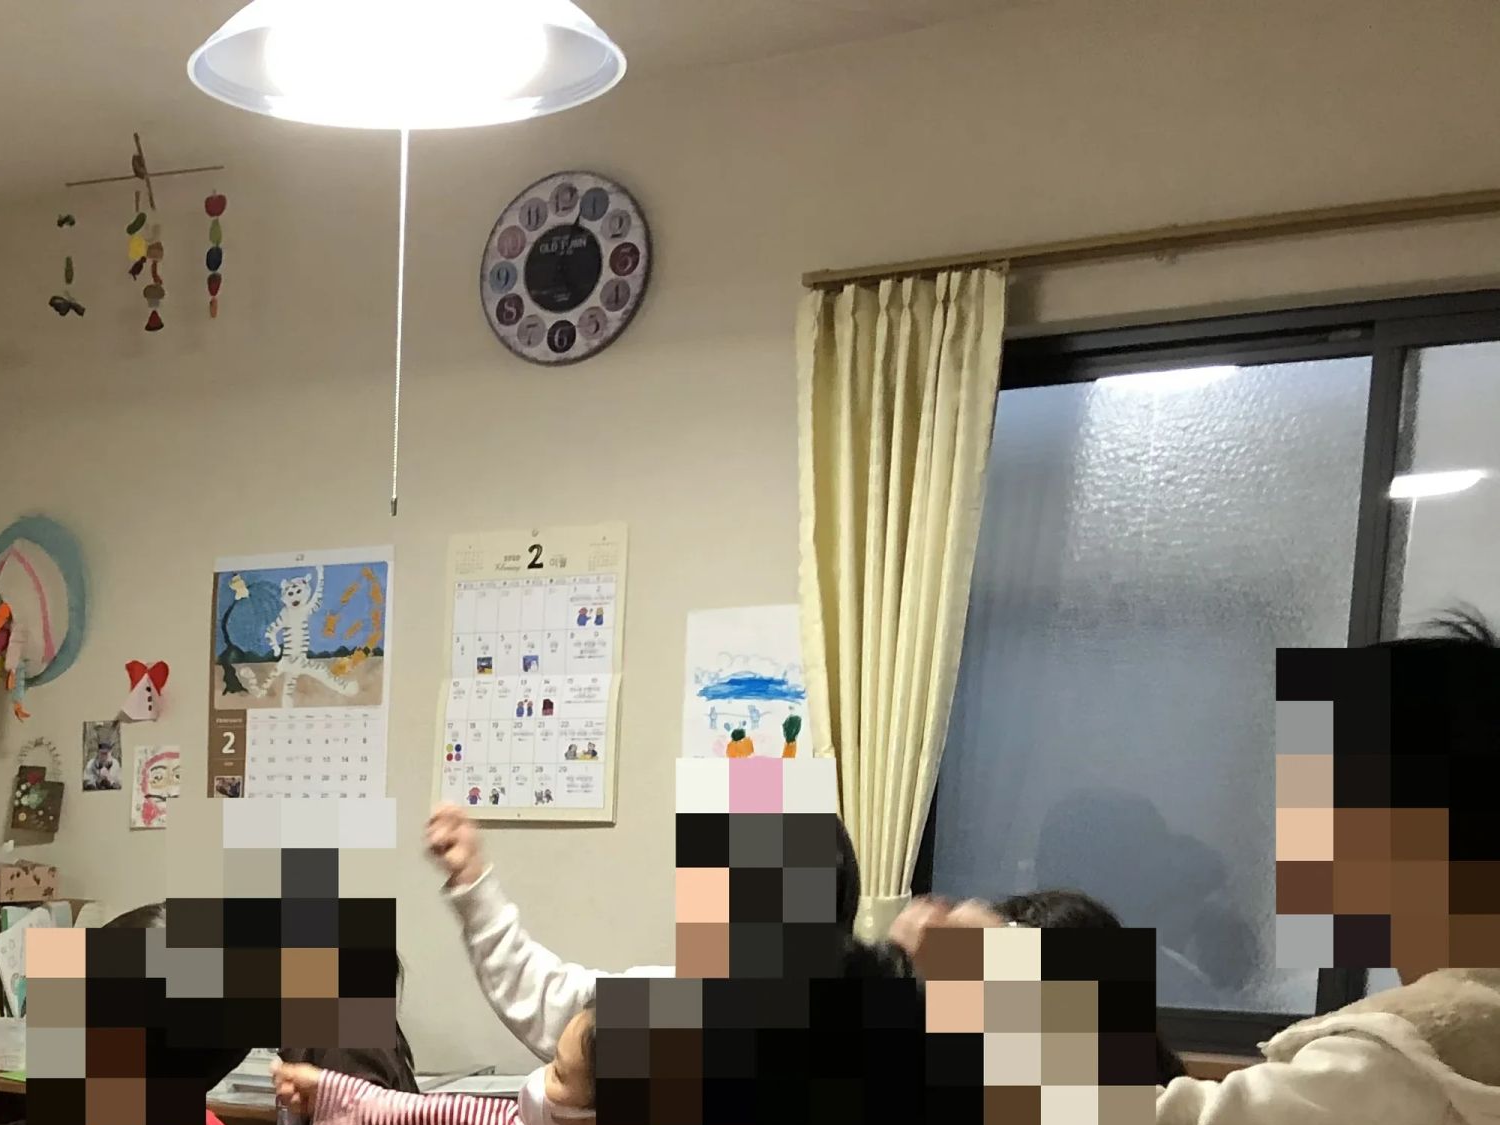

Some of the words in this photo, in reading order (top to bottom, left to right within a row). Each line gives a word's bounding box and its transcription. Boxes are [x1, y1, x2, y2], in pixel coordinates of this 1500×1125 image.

[555, 186, 577, 214] 12
[527, 207, 540, 227] 11
[609, 214, 624, 239] 2
[617, 247, 633, 273] 3
[497, 267, 510, 287] 9
[503, 302, 517, 322] 8
[526, 322, 539, 346] 7
[589, 313, 601, 334] 5
[554, 327, 568, 349] 6
[527, 544, 544, 569] 2
[513, 721, 523, 729] 20
[222, 731, 235, 754] 2
